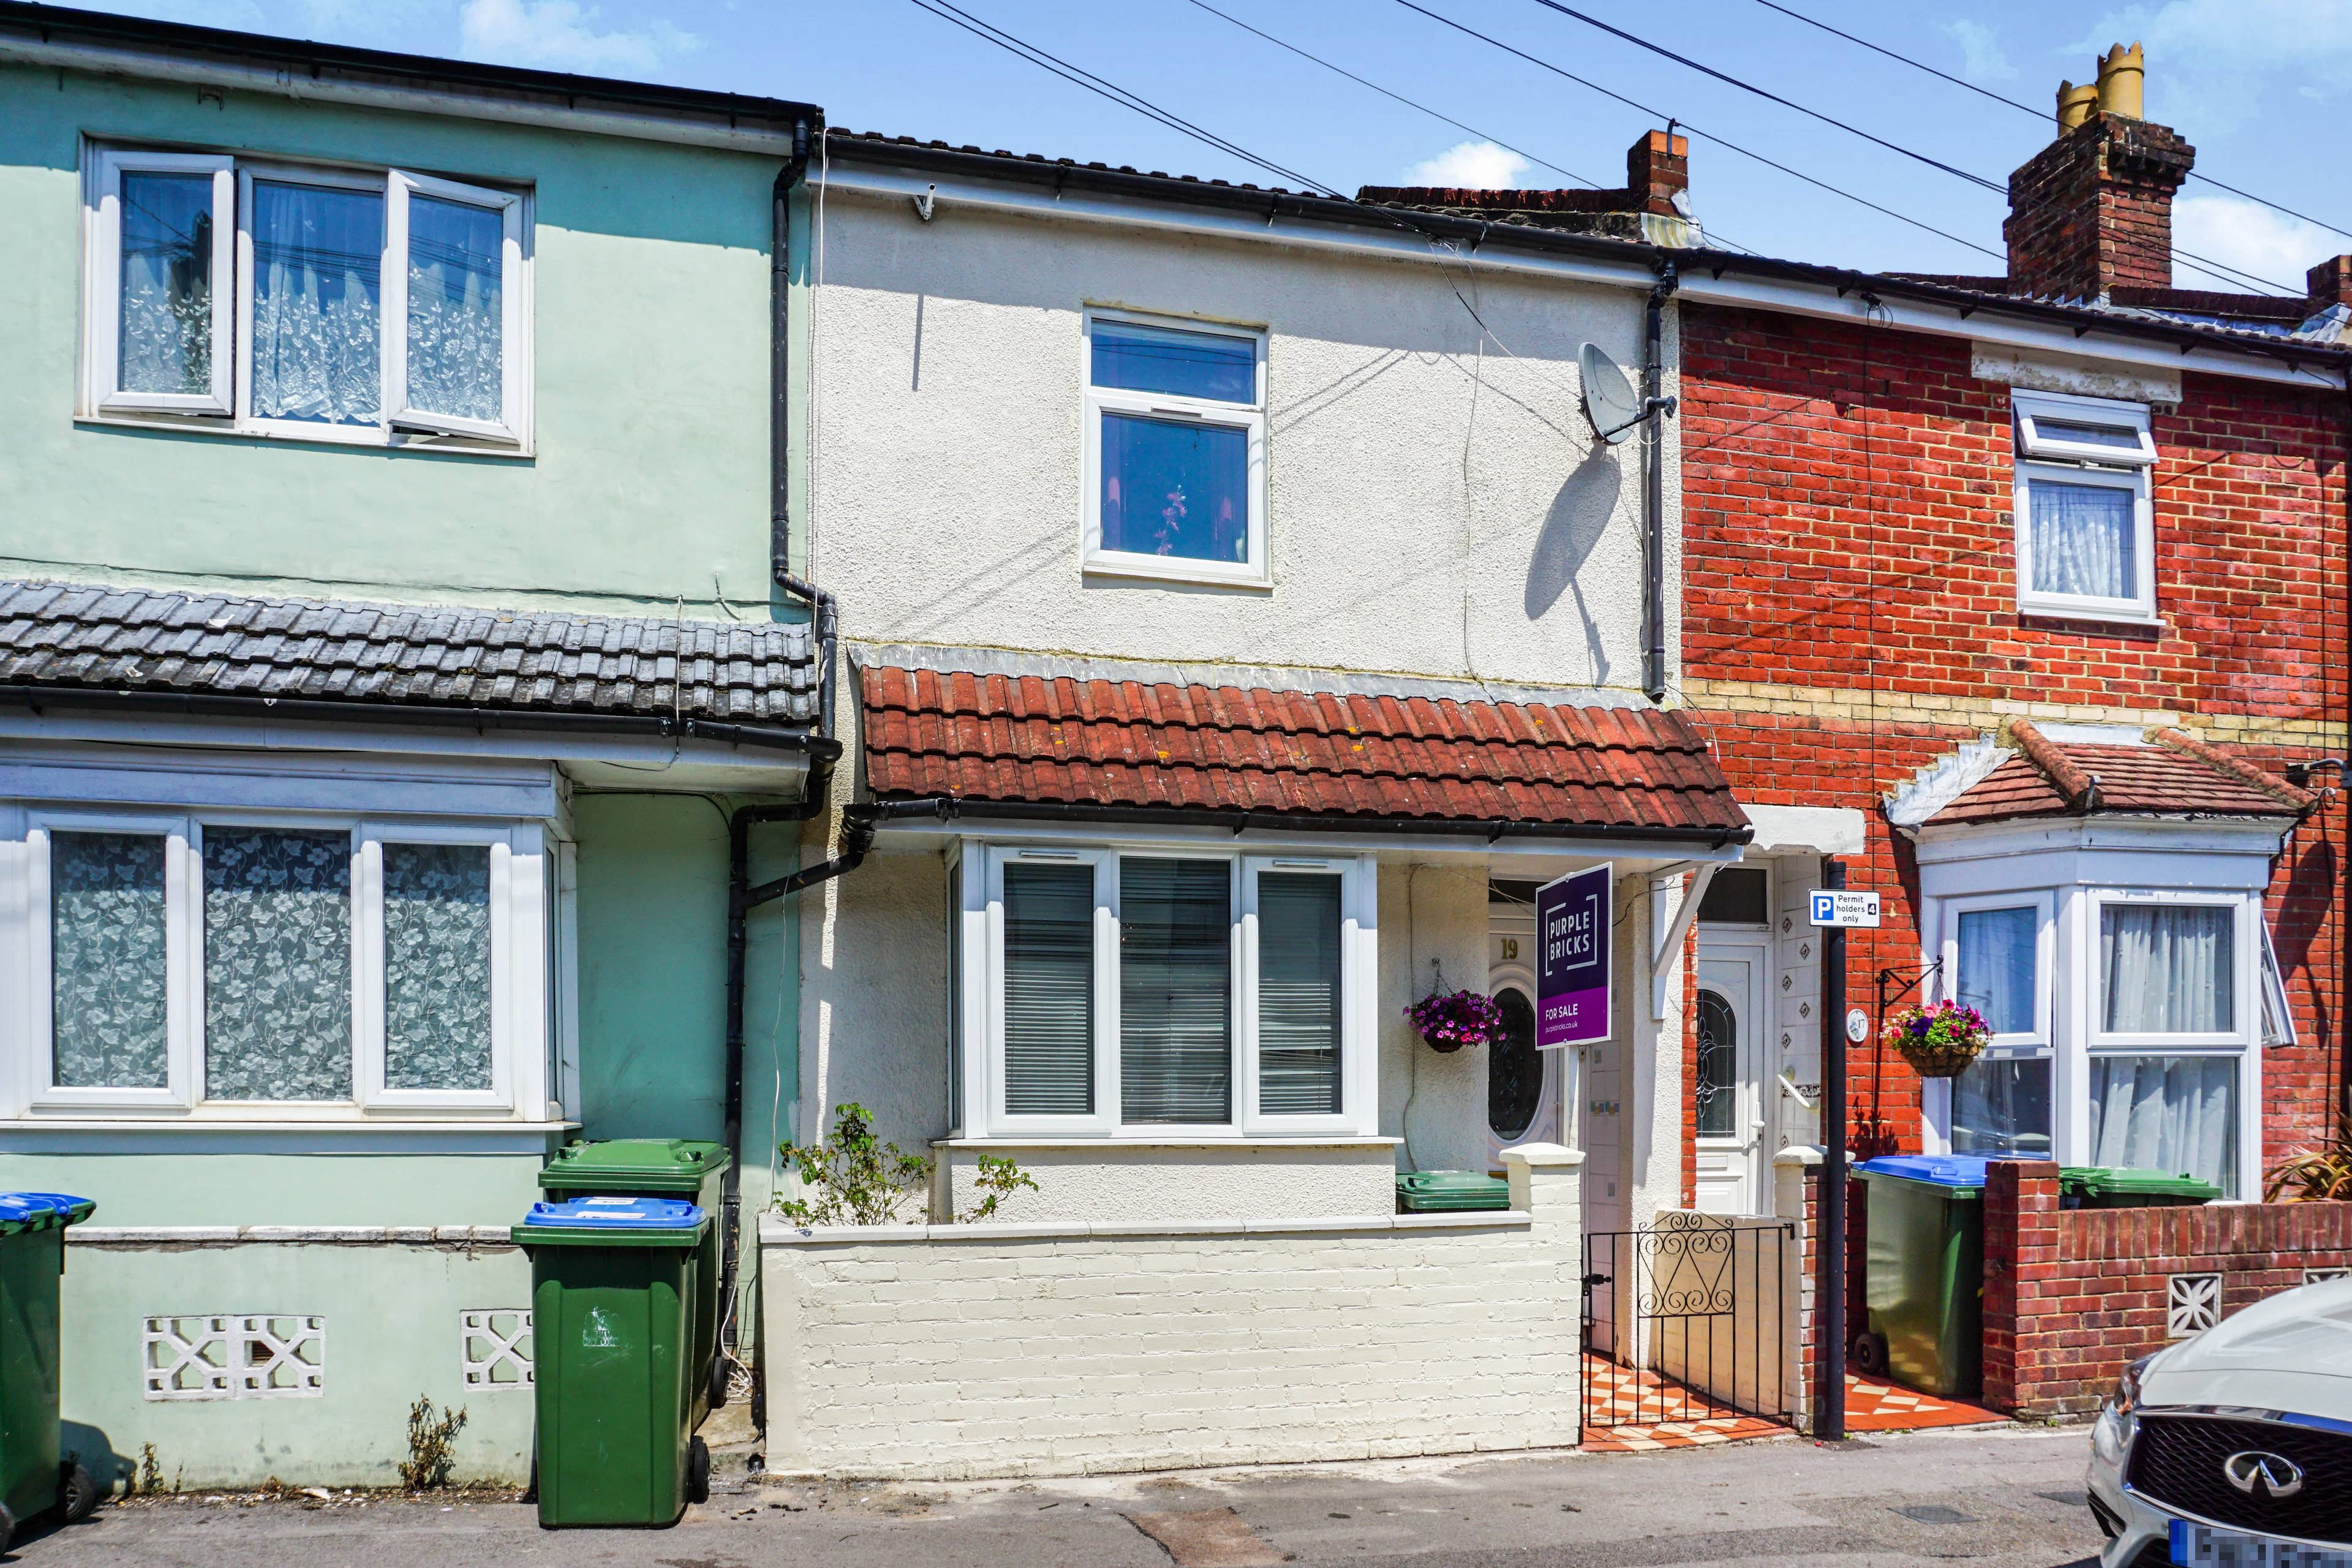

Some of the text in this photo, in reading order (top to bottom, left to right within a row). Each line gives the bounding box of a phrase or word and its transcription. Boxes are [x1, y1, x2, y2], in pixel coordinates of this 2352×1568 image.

[1817, 898, 1831, 918] P
[1836, 904, 1865, 913] holders
[1869, 905, 1875, 914] 4
[1550, 911, 1589, 939] PURPLE
[1842, 914, 1859, 924] only
[1501, 938, 1518, 960] 19
[1550, 933, 1589, 961] BRICKS
[1545, 1003, 1578, 1022] FOR SALE
[1858, 1019, 1865, 1028] 17
